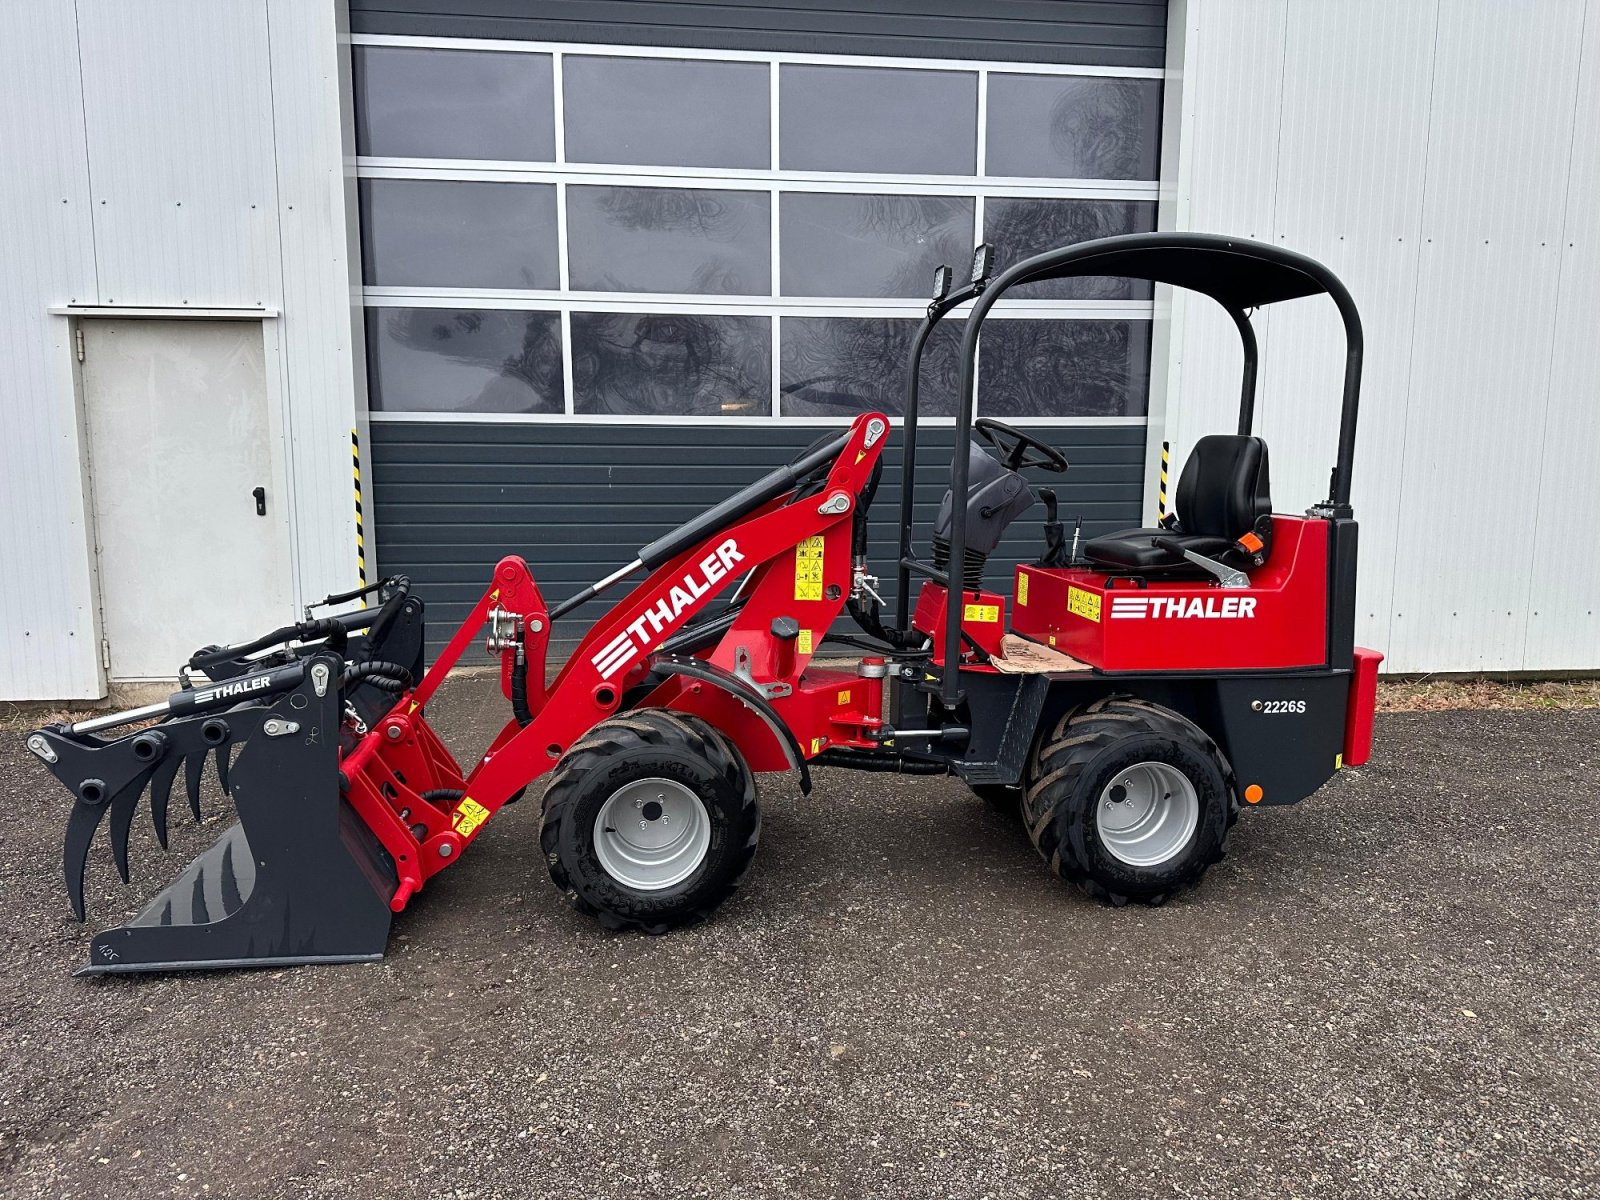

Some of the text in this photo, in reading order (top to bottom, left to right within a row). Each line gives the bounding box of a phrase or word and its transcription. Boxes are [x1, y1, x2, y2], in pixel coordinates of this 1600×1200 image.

[626, 538, 745, 645] THALER
[1149, 597, 1257, 619] THALER
[213, 676, 271, 699] THALER
[1263, 700, 1306, 714] 2226S
